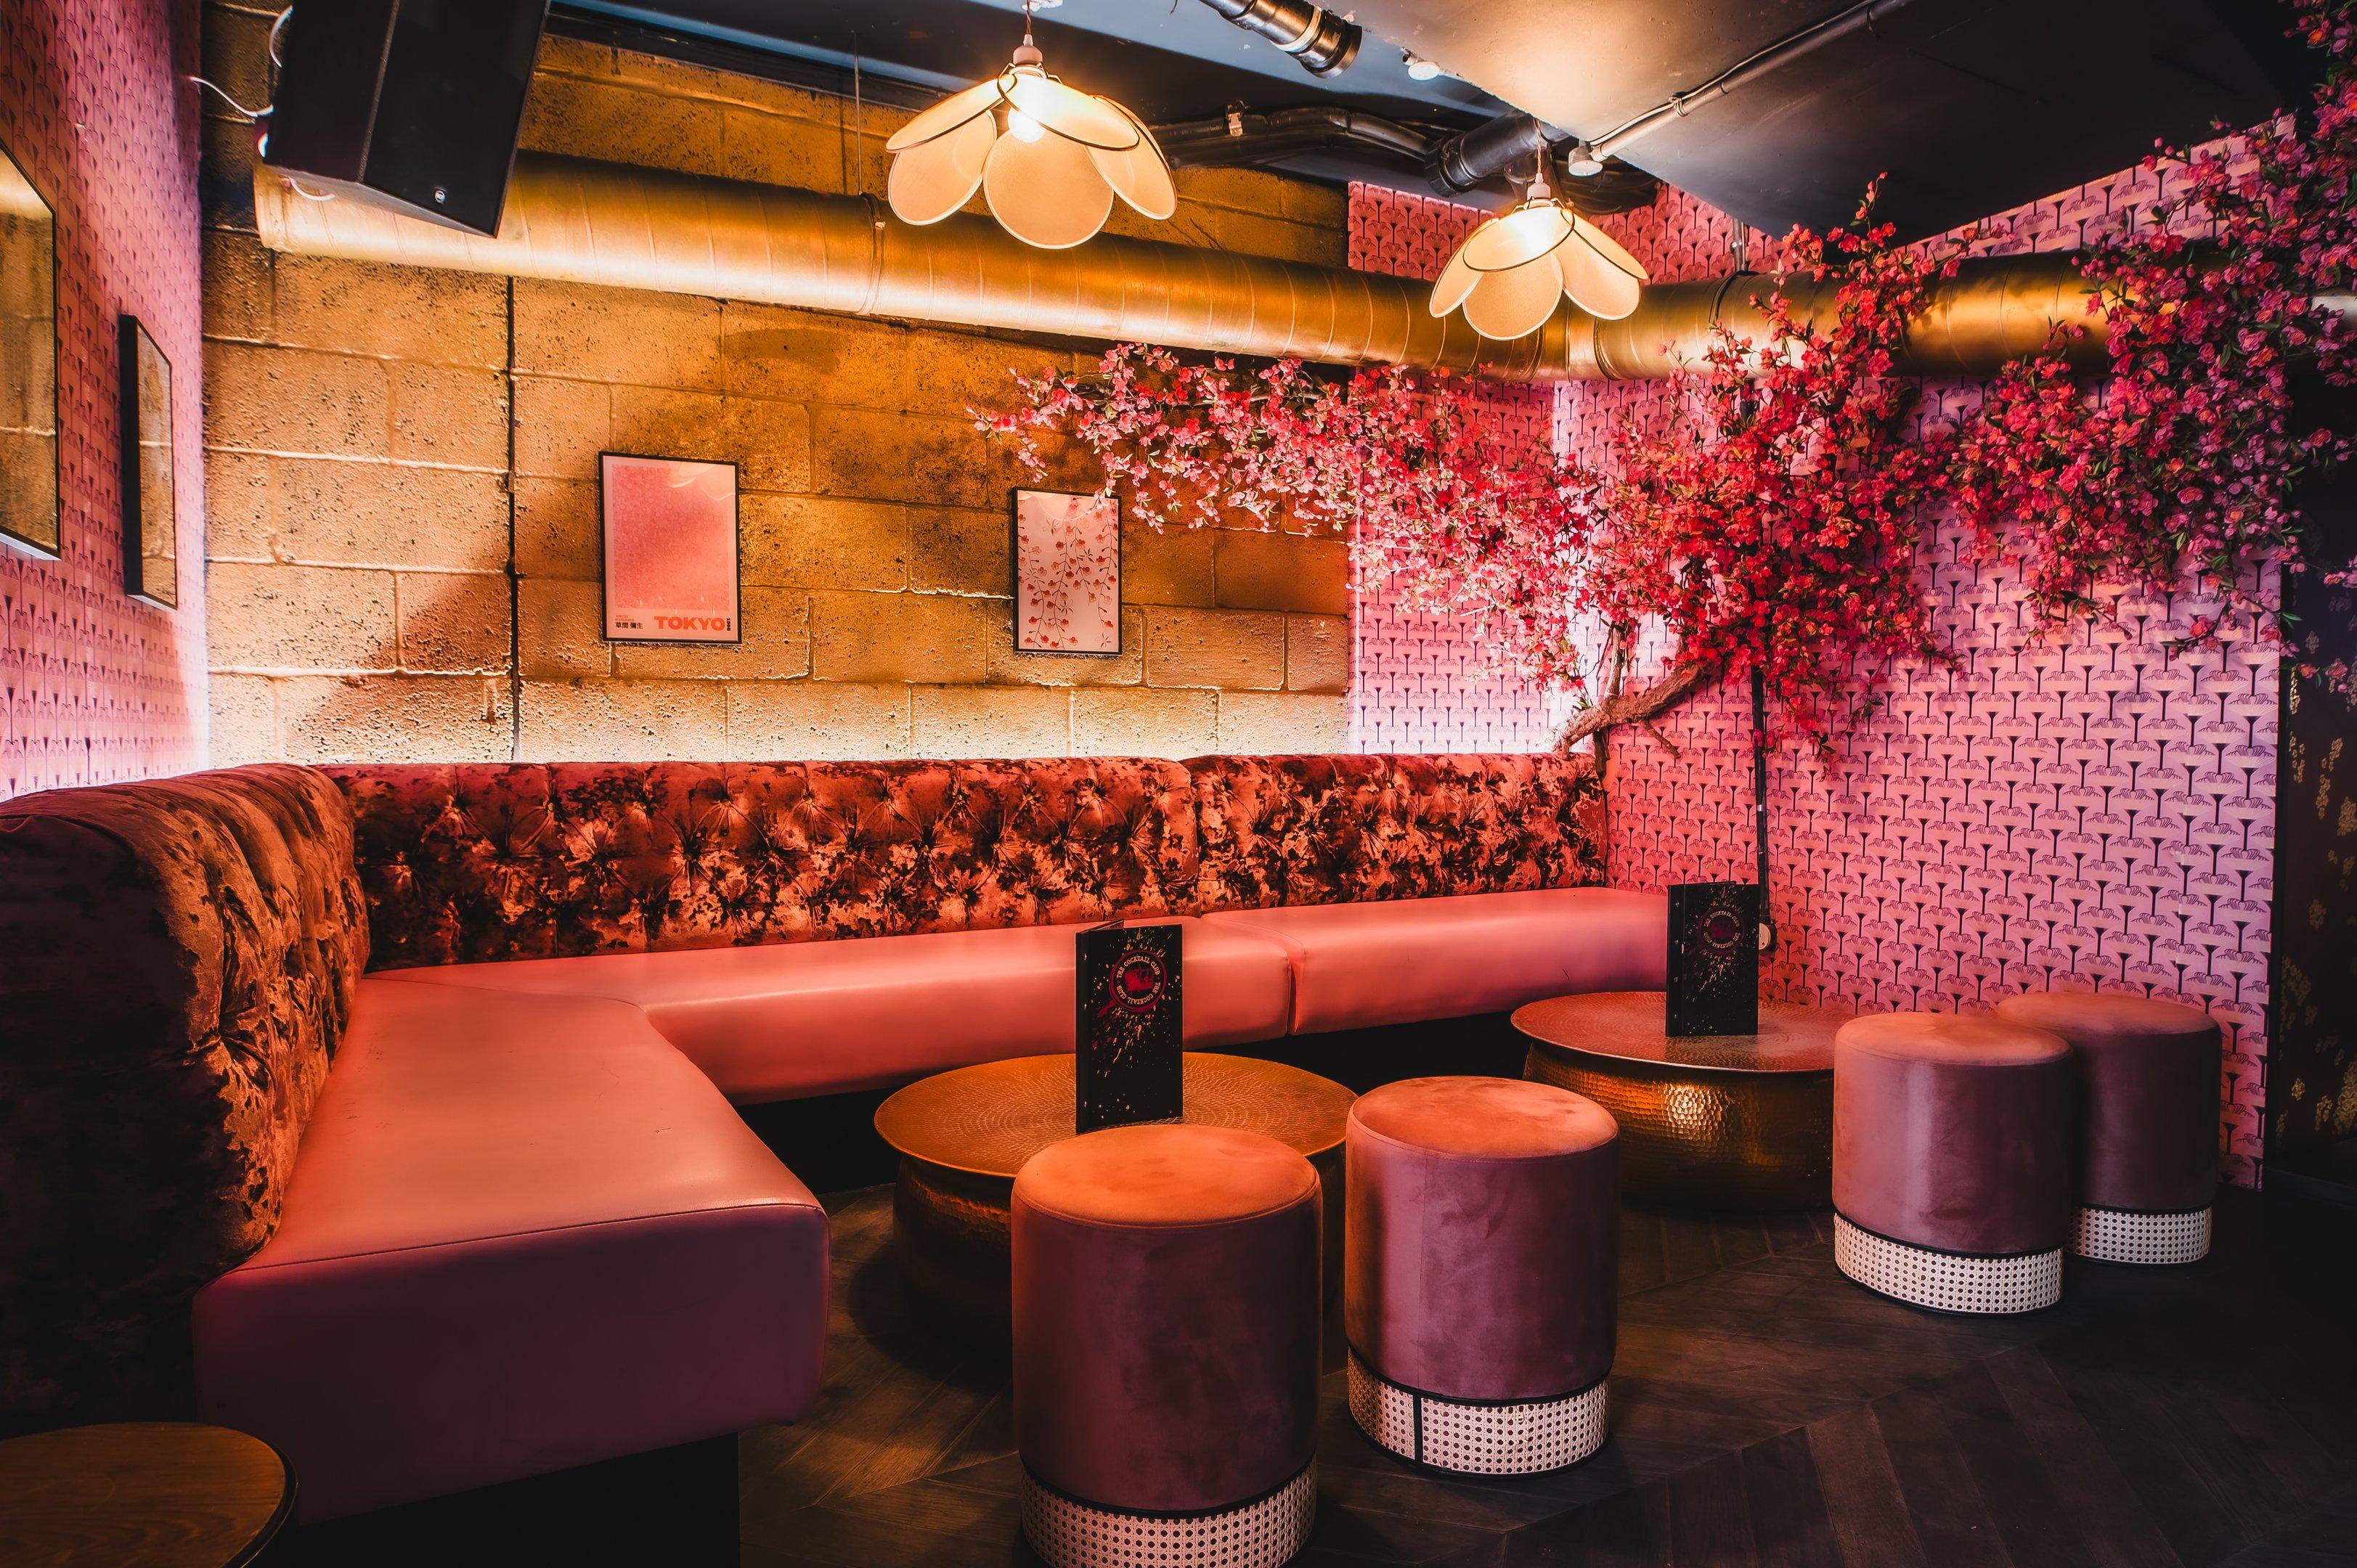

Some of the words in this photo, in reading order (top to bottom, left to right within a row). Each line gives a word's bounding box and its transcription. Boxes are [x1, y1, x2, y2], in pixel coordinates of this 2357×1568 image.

[654, 616, 725, 631] TOKYO
[1123, 955, 1150, 967] COCKTAIL
[1150, 961, 1161, 976] CLUB
[1117, 985, 1127, 1000] CLUB
[1152, 981, 1161, 994] THE
[1127, 993, 1154, 1005] COCKTAIL
